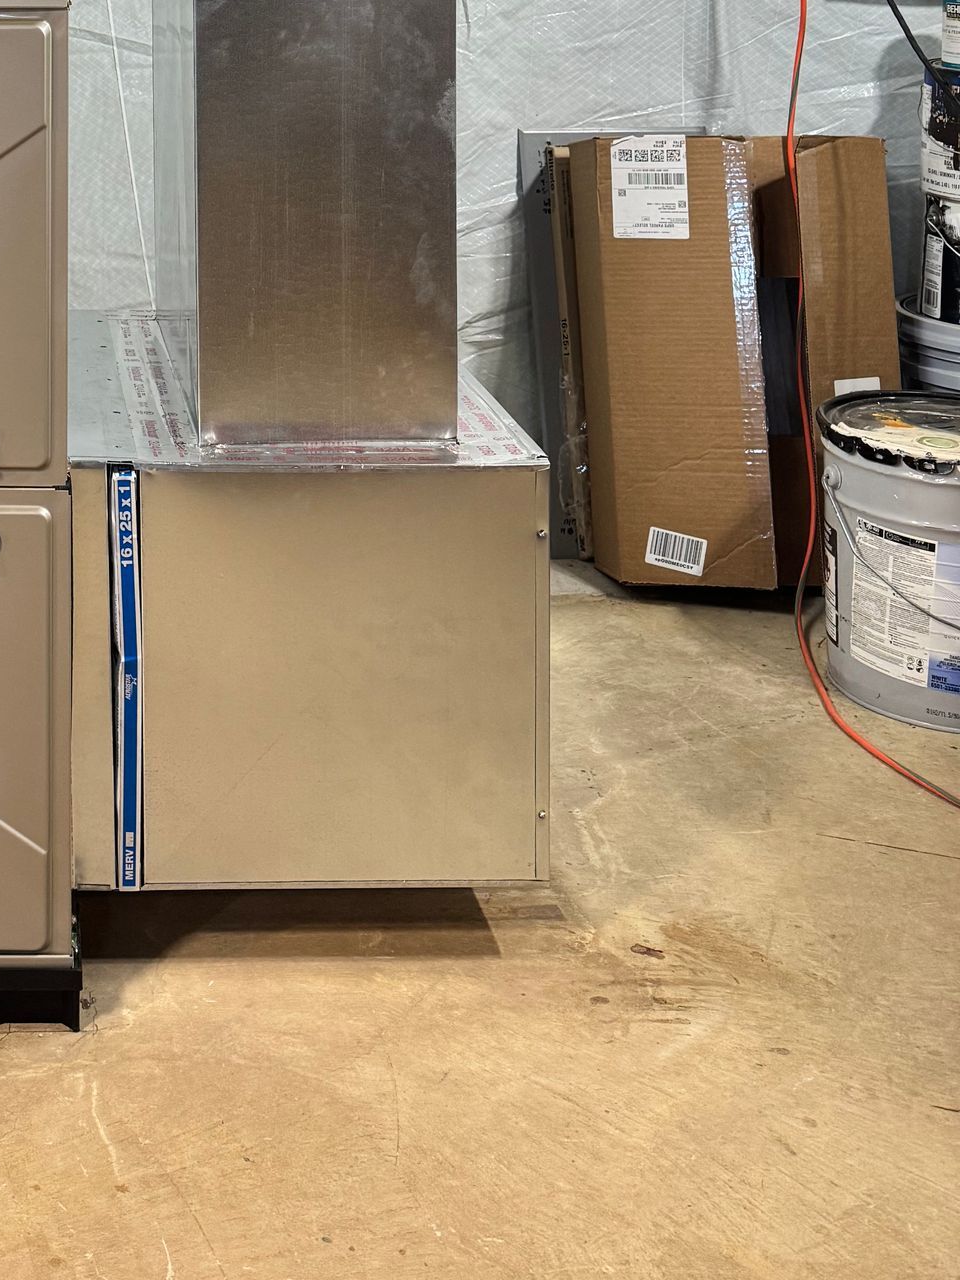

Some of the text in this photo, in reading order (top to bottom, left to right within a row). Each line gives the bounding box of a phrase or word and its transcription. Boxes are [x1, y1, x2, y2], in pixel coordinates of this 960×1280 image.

[118, 485, 133, 568] 16 x 25 x 1
[124, 850, 134, 880] MERV
